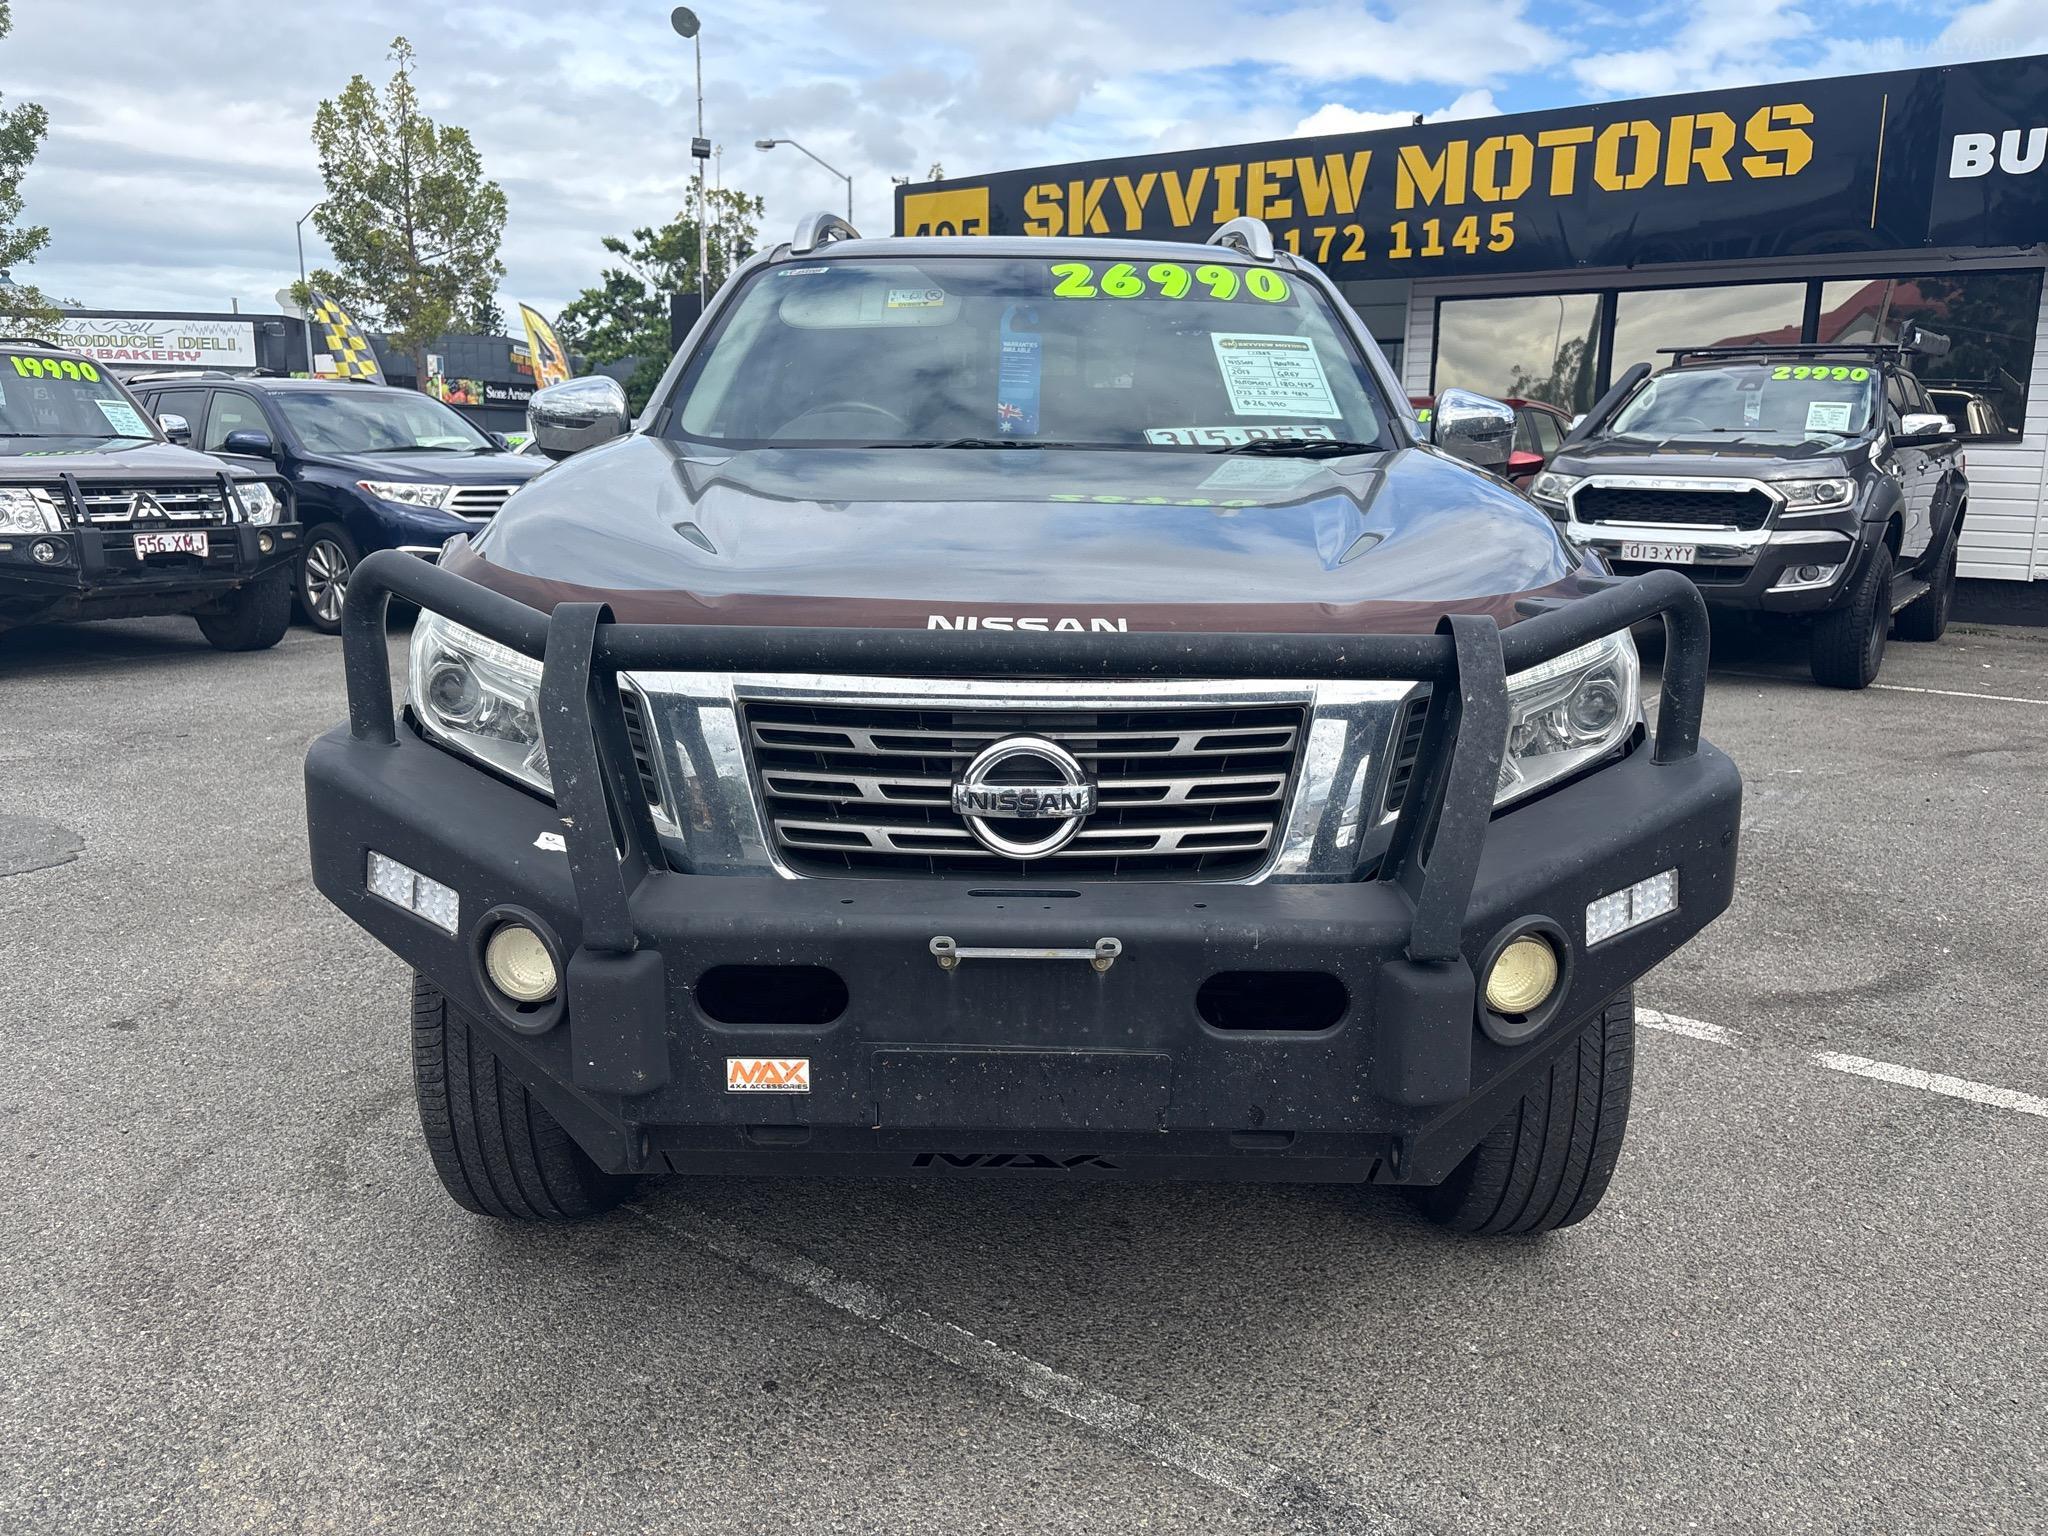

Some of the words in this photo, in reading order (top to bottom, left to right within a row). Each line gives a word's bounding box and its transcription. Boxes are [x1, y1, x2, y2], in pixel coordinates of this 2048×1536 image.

[1949, 127, 2048, 178] BU
[1023, 149, 1373, 237] SKYVIEW
[1395, 103, 1815, 210] MOTORS
[1270, 224, 1366, 263] 172
[1388, 211, 1515, 259] 1145
[1051, 263, 1291, 302] 26990
[97, 349, 201, 361] BAKERY
[11, 356, 100, 383] 19990
[1771, 366, 1870, 382] 29990
[927, 615, 1128, 632] NISSAN
[968, 792, 1082, 811] NISSAN
[729, 1061, 806, 1083] MAX
